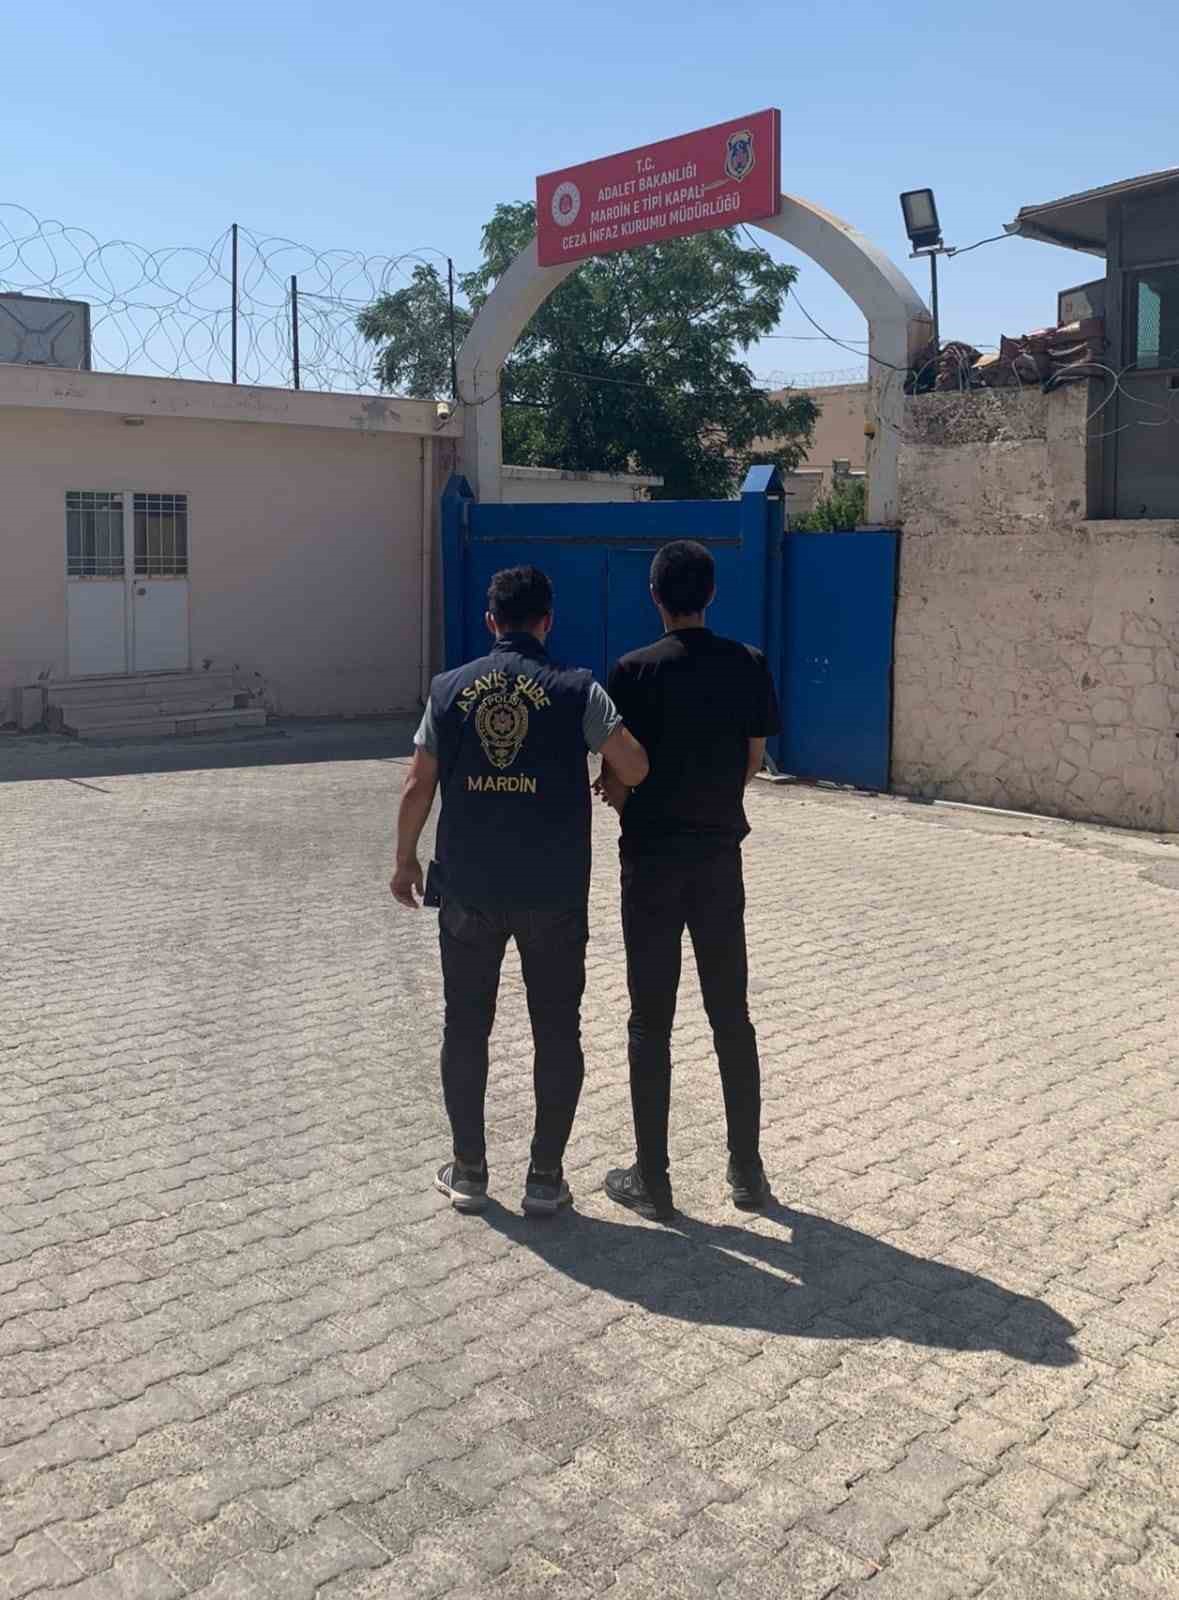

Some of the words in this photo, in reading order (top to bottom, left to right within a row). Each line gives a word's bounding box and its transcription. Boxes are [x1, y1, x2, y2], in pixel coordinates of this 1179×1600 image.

[598, 180, 636, 202] ADALET
[639, 161, 697, 191] BAKANLIĞI
[636, 157, 655, 173] T.C.
[562, 232, 588, 250] CEZA
[589, 225, 619, 242] İNFAZ
[621, 214, 667, 236] KURUMU
[669, 191, 741, 225] MÜDÜRLÜĞÜ
[590, 201, 631, 224] MARDİN
[633, 200, 640, 214] E
[643, 191, 662, 211] TİPİ
[467, 772, 537, 793] MARDİN
